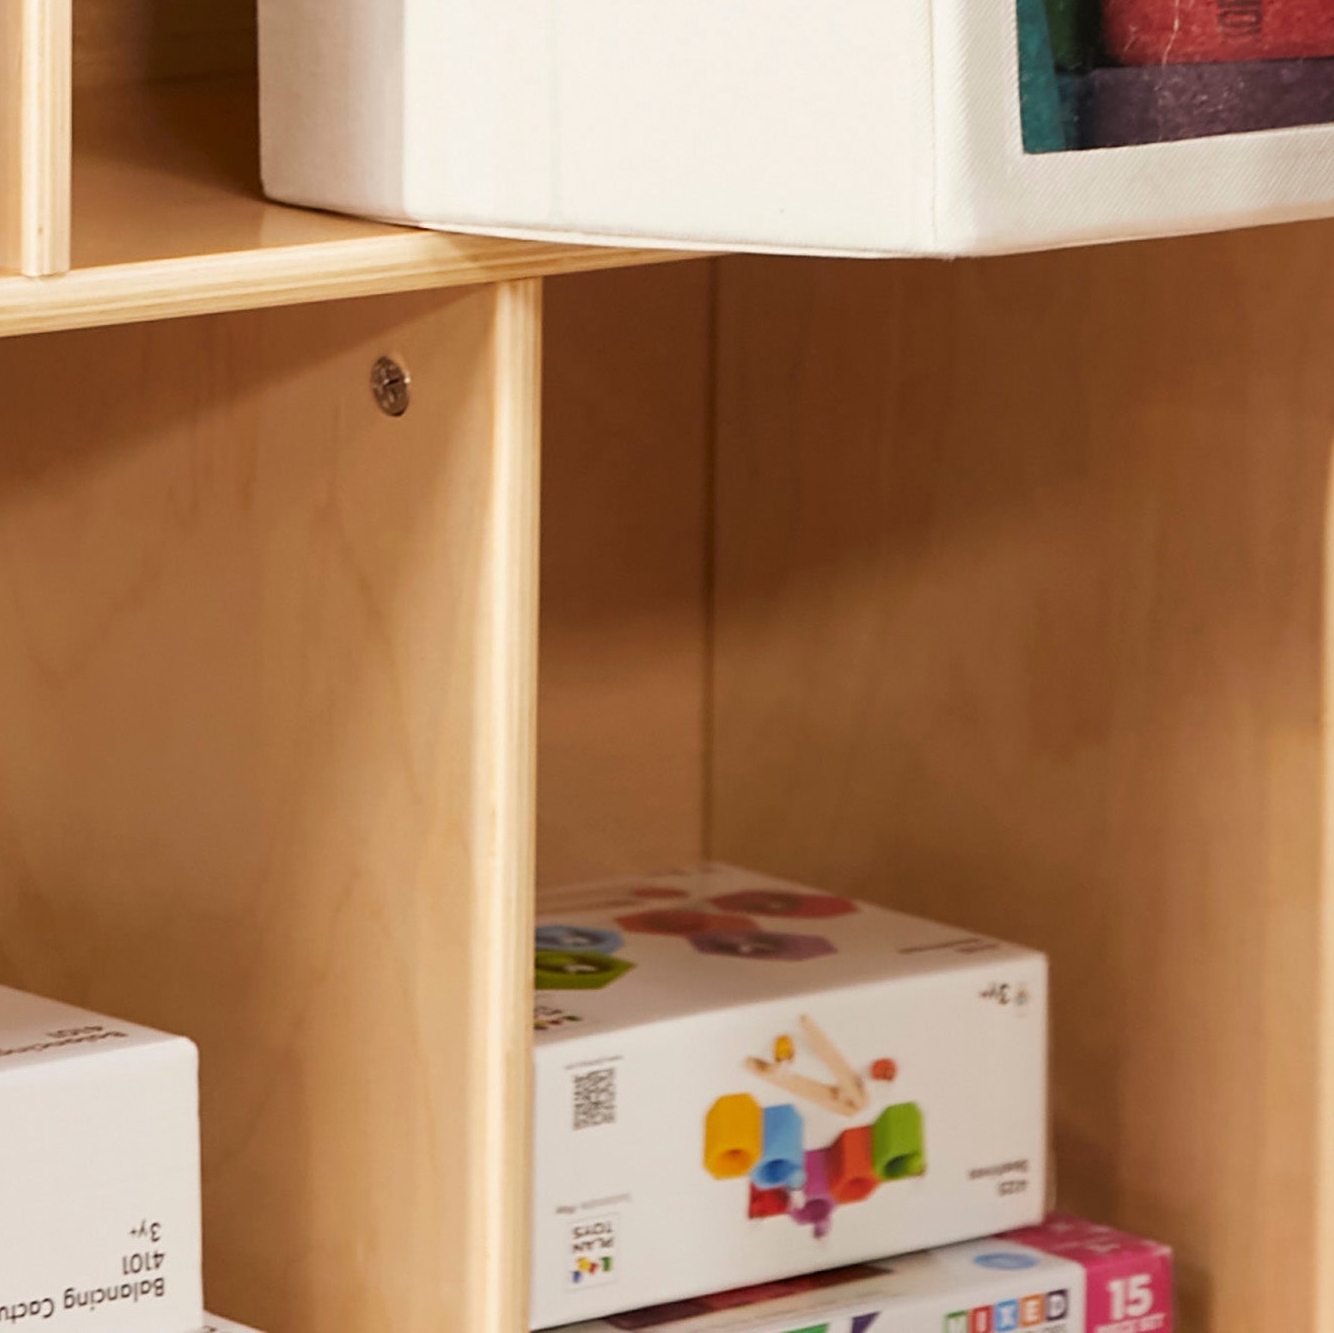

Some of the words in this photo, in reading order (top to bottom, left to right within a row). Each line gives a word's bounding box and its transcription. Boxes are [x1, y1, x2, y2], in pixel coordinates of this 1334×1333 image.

[130, 1220, 162, 1243] 3y+
[122, 1251, 165, 1275] 4101
[63, 1278, 165, 1311] Balancing
[1107, 1273, 1154, 1321] 15
